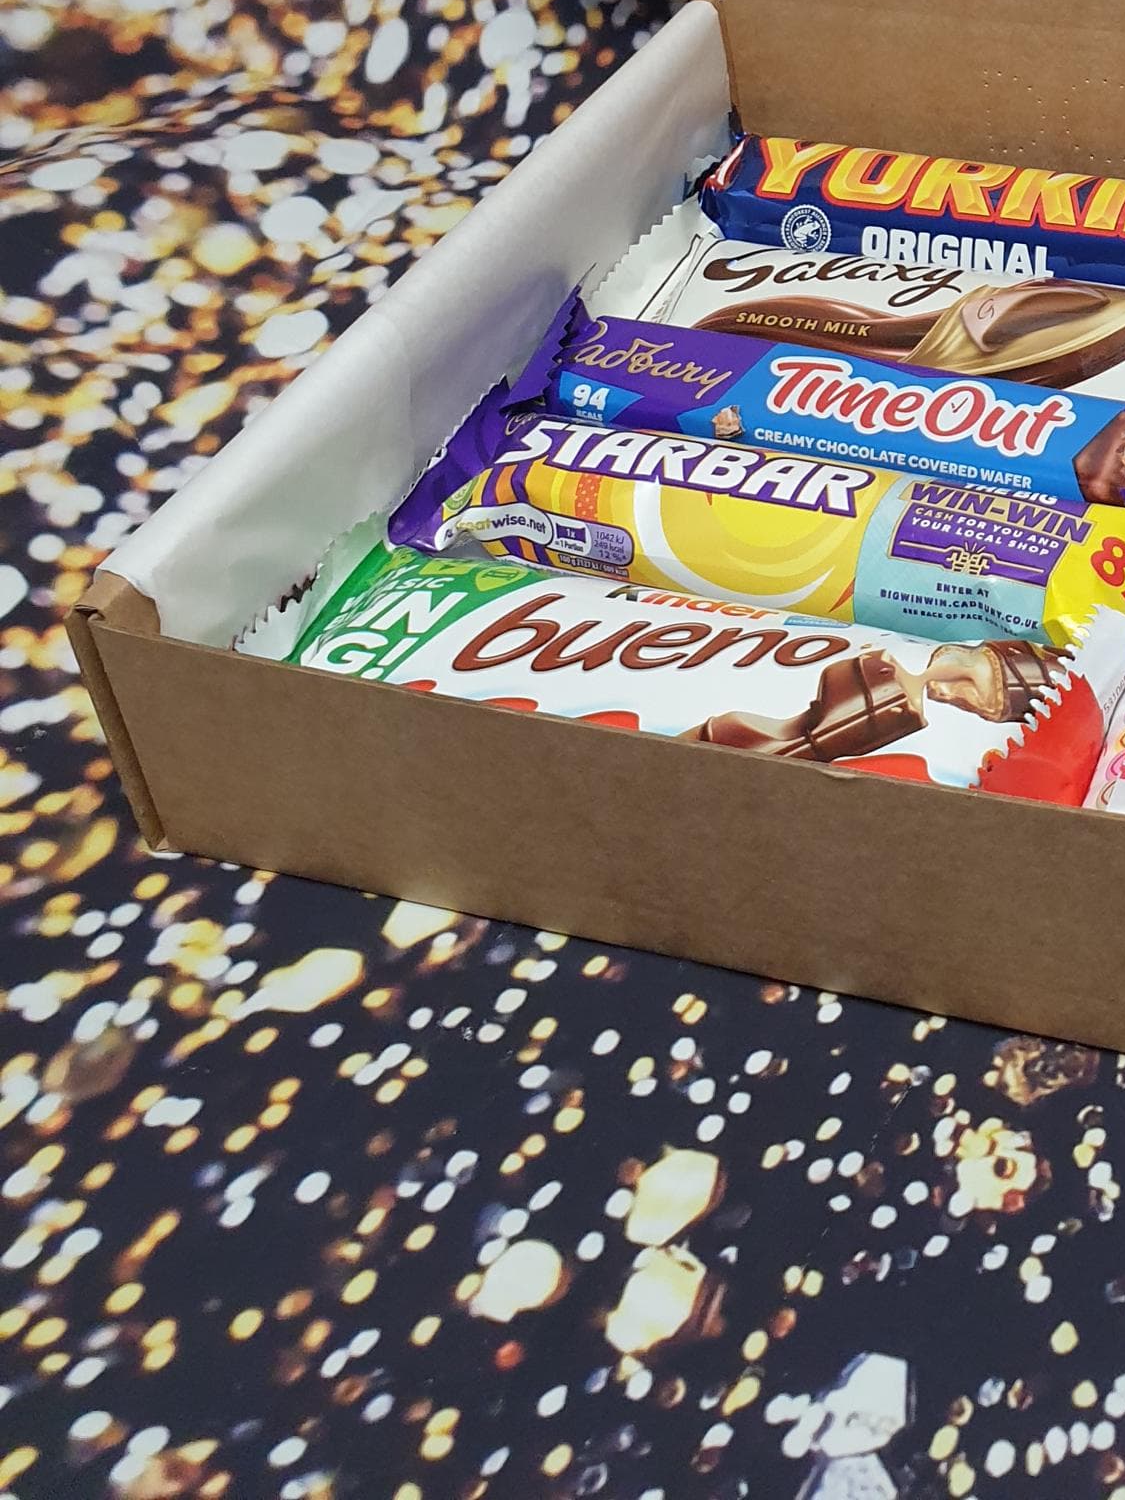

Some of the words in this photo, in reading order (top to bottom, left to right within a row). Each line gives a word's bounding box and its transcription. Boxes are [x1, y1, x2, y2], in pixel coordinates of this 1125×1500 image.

[861, 224, 1056, 278] ORIGINAL
[702, 248, 964, 308] Galaxy
[735, 311, 819, 332] SMOOTH
[822, 320, 872, 338] MILK
[572, 383, 611, 412] 94
[494, 419, 870, 512] STARBAR
[753, 426, 815, 450] CREAMY
[815, 438, 907, 466] CHOCOLATE
[907, 454, 979, 479] COVERED
[979, 467, 1033, 490] WAFER
[910, 482, 1094, 544] WIN-WIN
[911, 517, 951, 534] YOUR
[955, 526, 1003, 546] LOCAL
[1007, 539, 1051, 557] SHOP
[914, 506, 955, 523] CASH
[956, 516, 988, 531] FOR
[992, 523, 1024, 540] YOU
[1022, 533, 1061, 551] AND
[879, 588, 1040, 631] BIGWINWIN.CADBURY.CO.UK
[935, 582, 974, 596] ENTER
[976, 587, 990, 599] AT
[451, 592, 852, 673] bueno
